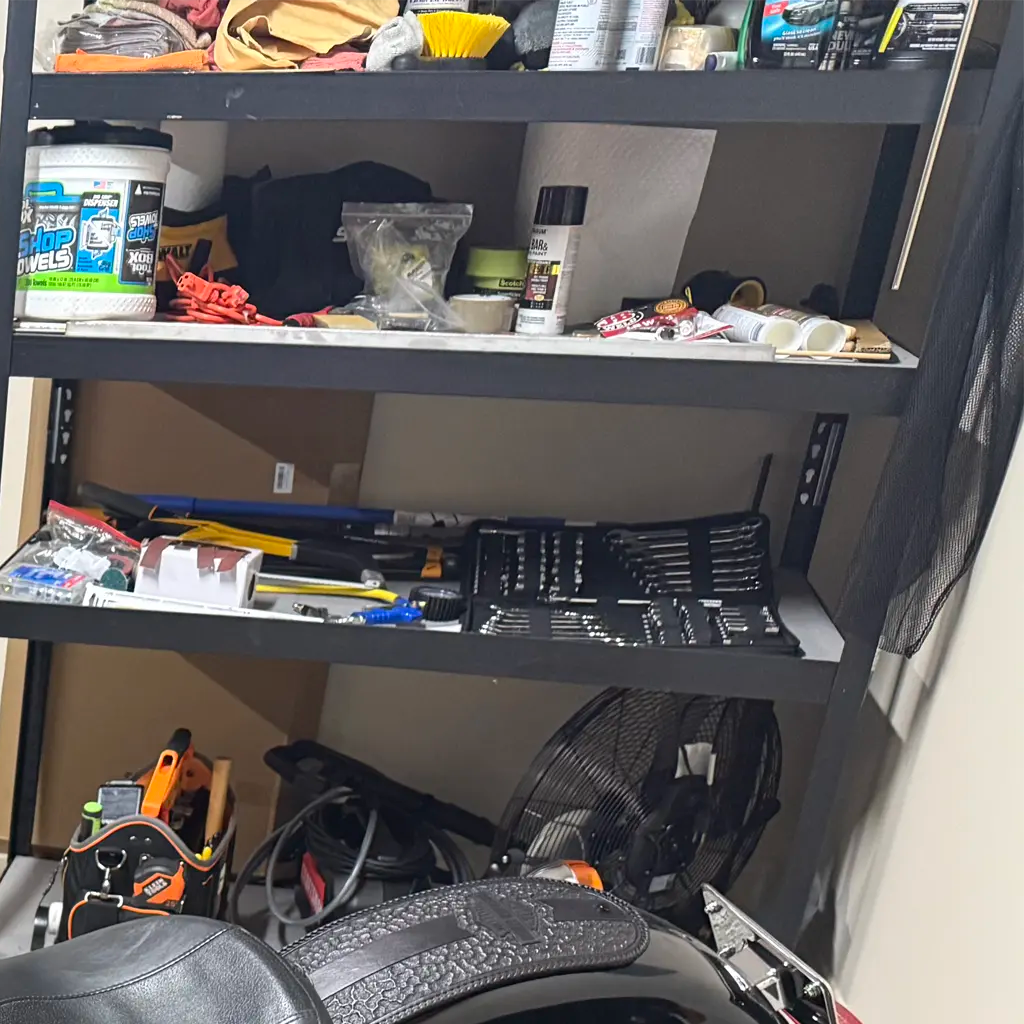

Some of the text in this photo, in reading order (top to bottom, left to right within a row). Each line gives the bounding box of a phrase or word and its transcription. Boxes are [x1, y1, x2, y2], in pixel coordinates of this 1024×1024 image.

[19, 226, 73, 257] SHOP
[17, 249, 72, 275] OWELS
[500, 278, 525, 287] Scotch
